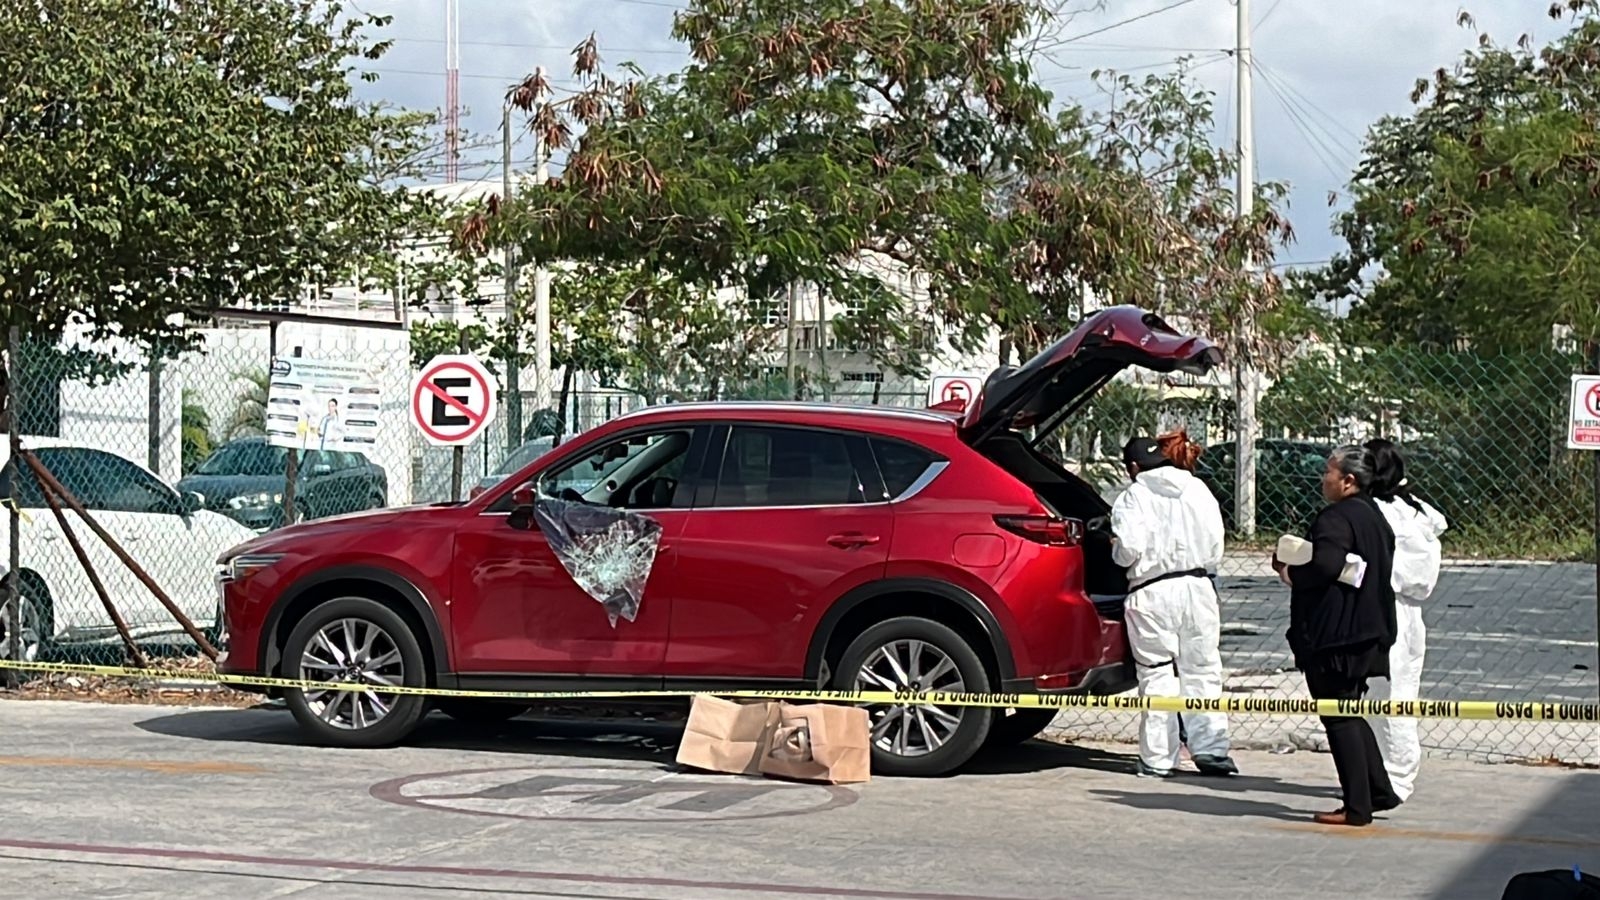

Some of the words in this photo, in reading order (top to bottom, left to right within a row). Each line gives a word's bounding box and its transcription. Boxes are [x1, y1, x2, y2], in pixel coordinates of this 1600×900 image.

[432, 377, 471, 426] E
[1038, 695, 1087, 706] POLICIA
[1092, 696, 1108, 707] DE
[1114, 697, 1151, 709] LINEA
[1185, 698, 1220, 710] PASO
[1227, 699, 1240, 711] EL
[1244, 699, 1318, 713] PROHIBIDO
[1337, 699, 1391, 715] POLICIA
[1396, 701, 1414, 715] DE
[1419, 701, 1459, 716] LINEA
[1495, 702, 1533, 719] PASO
[1541, 703, 1554, 719] EL
[1559, 704, 1600, 721] IBIDO
